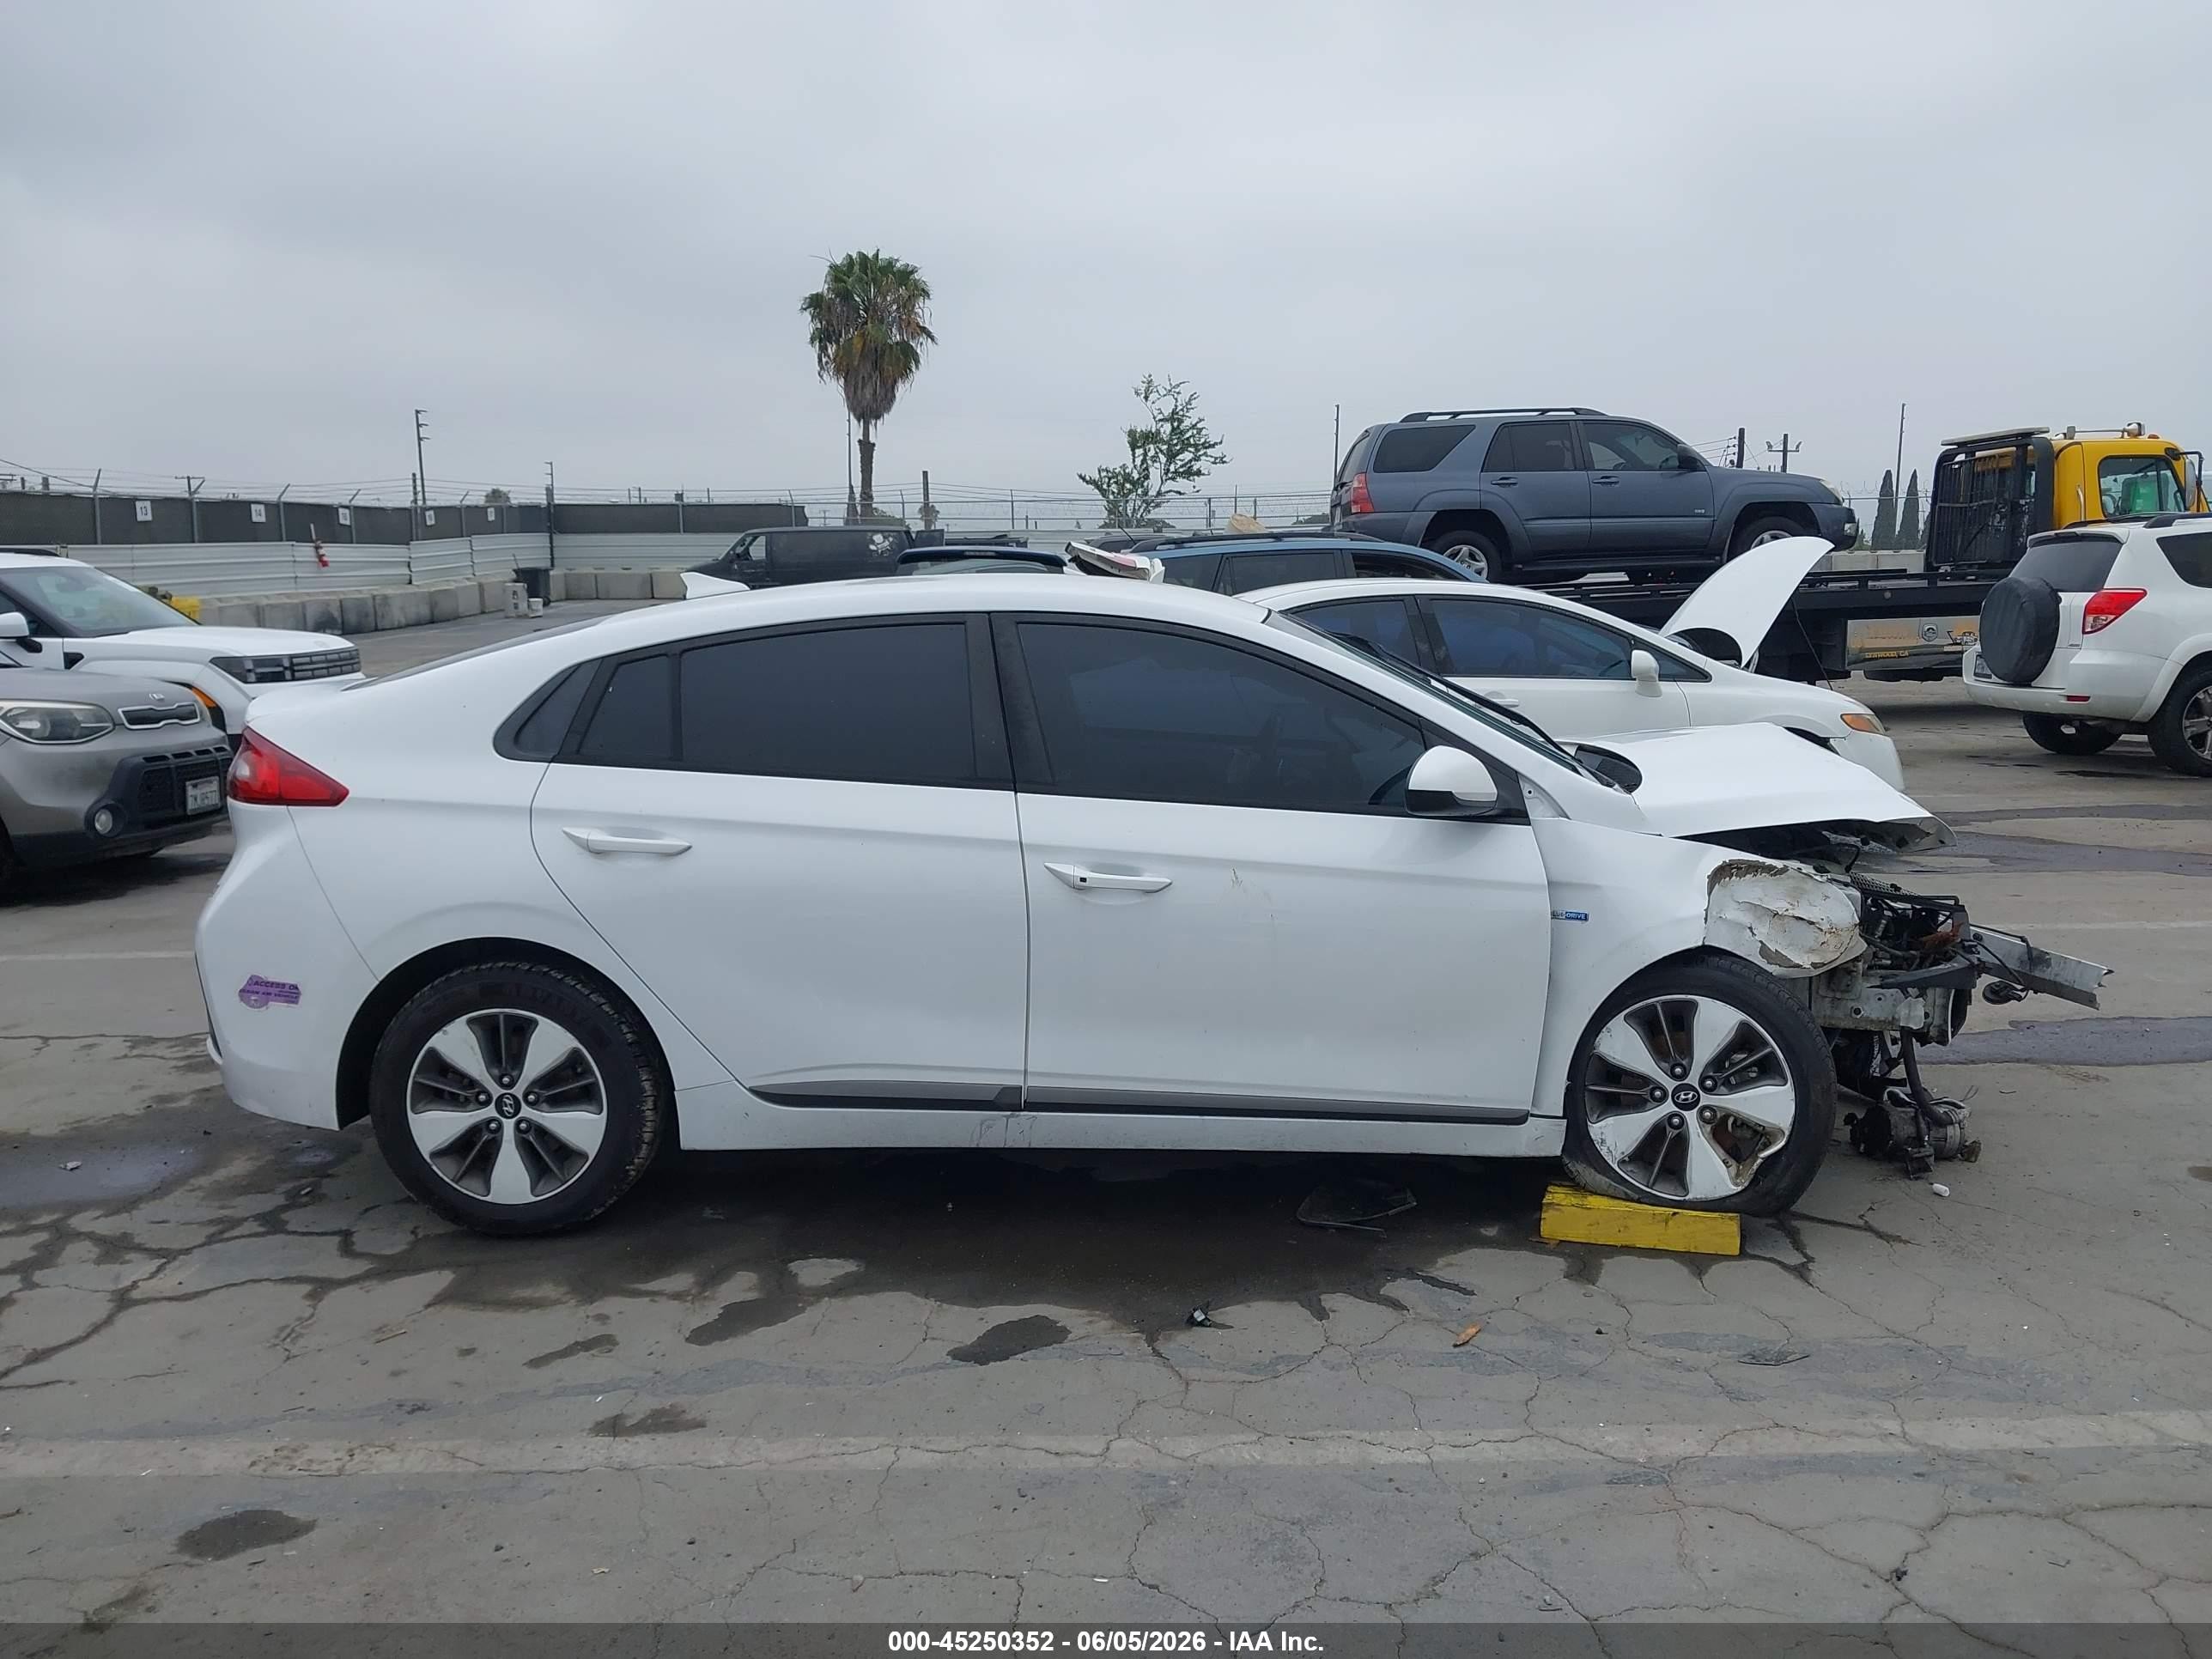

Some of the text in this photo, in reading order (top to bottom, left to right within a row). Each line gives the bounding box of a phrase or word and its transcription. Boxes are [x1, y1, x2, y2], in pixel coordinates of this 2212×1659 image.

[139, 505, 149, 516] 13
[254, 508, 262, 517] 14
[1566, 911, 1586, 920] DRIVE
[254, 981, 285, 990] ACCESS
